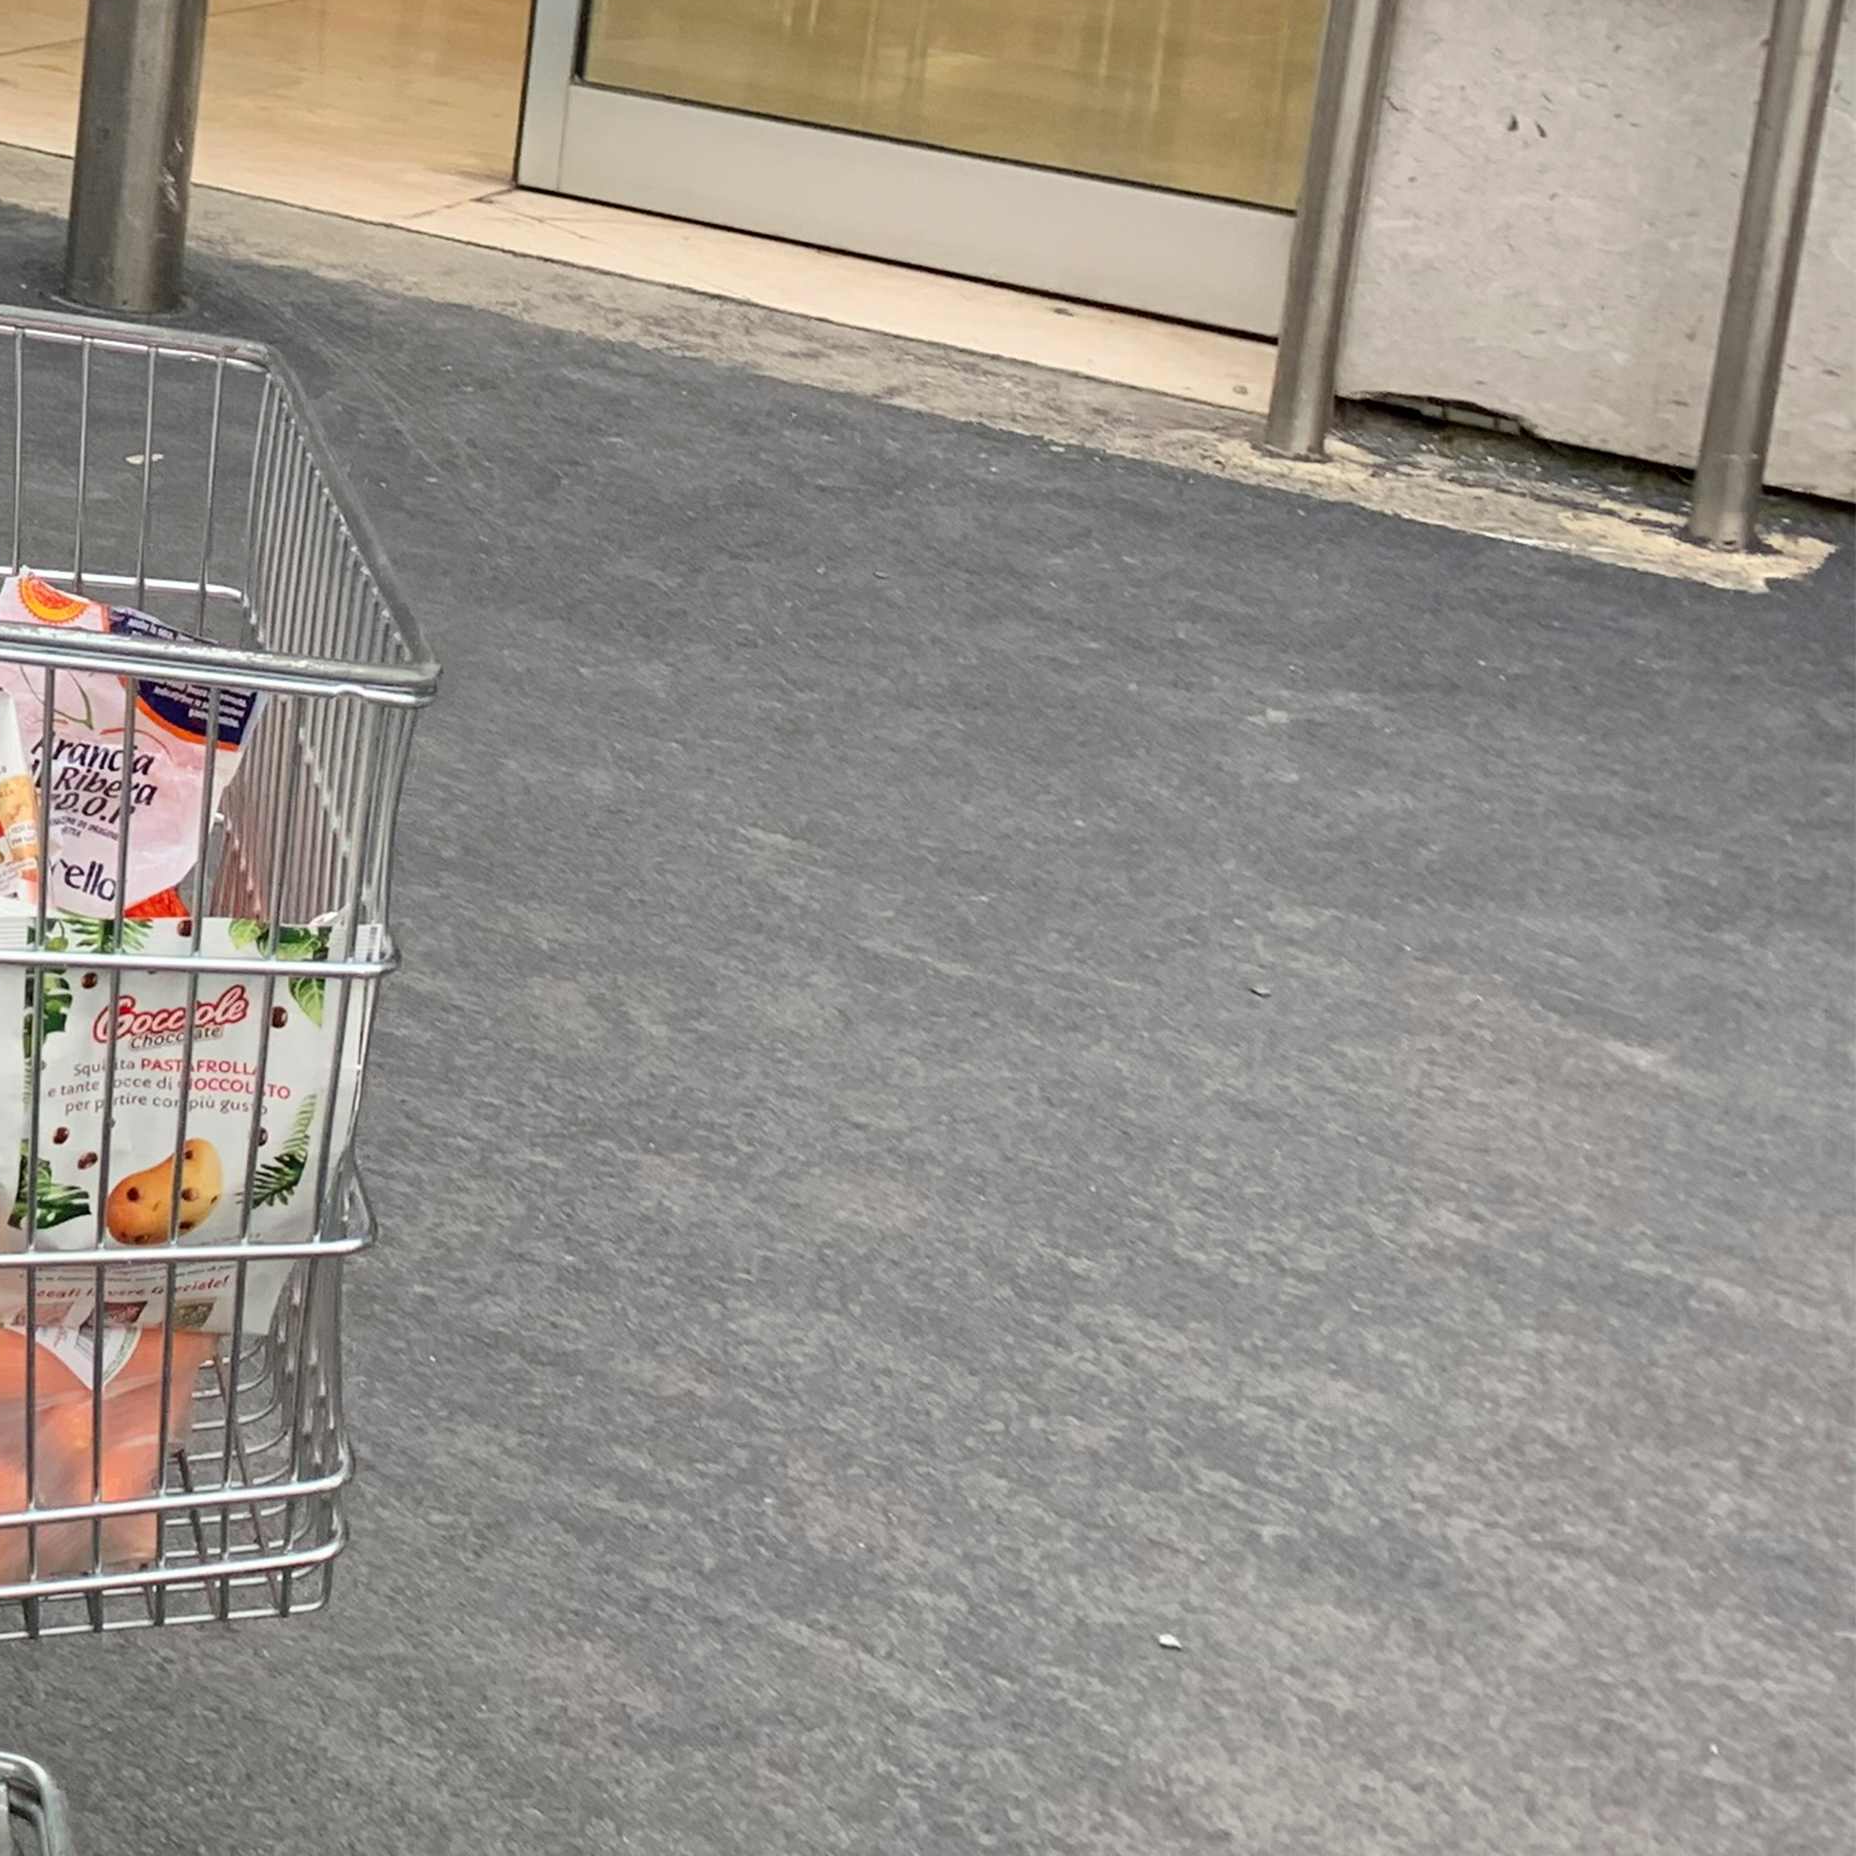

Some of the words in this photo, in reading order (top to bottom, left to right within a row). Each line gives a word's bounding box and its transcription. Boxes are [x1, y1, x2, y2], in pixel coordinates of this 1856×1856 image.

[31, 734, 156, 777] ranca
[92, 984, 250, 1044] Goccole
[130, 1025, 222, 1050] Chocoate
[73, 1058, 136, 1077] Squiita
[48, 1087, 57, 1098] e
[60, 1080, 100, 1096] tante
[109, 1075, 152, 1090] occe
[156, 1075, 173, 1090] di
[177, 1077, 291, 1100] IOCCOLTO
[64, 1098, 90, 1116] per
[94, 1093, 148, 1114] prtire
[187, 1092, 215, 1114] più
